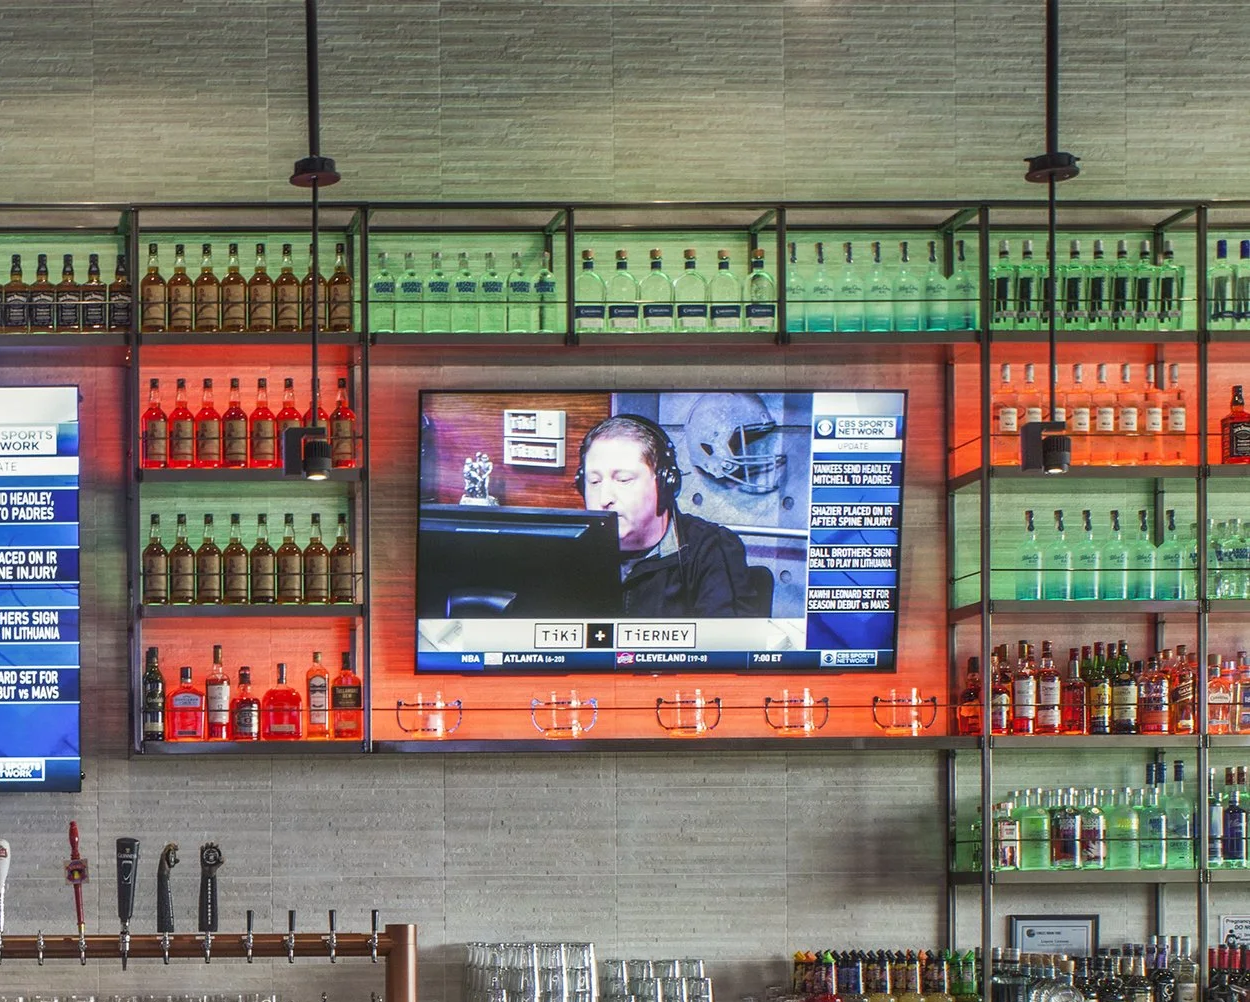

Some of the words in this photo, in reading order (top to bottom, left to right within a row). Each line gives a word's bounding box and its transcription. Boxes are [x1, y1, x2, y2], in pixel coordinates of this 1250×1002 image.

[838, 420, 856, 428] CBS
[859, 420, 894, 428] SPORTS
[2, 430, 53, 441] SPORTS
[838, 442, 868, 450] UPDATE
[813, 464, 842, 474] YANKEES
[844, 464, 861, 474] SEND
[862, 464, 892, 474] HEADLEY,
[813, 475, 850, 484] MITCHELL
[852, 475, 860, 484] TO
[862, 475, 892, 484] PADRES
[10, 492, 54, 507] HEADLEY,
[12, 506, 54, 520] PADRES
[812, 506, 842, 516] SHAZIER
[844, 506, 871, 516] PLACED
[873, 506, 882, 516] ON
[884, 506, 892, 516] IR
[812, 517, 836, 526] AFTER
[838, 517, 862, 526] SPINE
[864, 517, 892, 526] INJURY
[28, 551, 43, 564] ON
[46, 551, 58, 564] IR
[810, 548, 830, 557] BALL
[832, 548, 872, 557] BROTHERS
[873, 548, 892, 557] SIGN
[810, 558, 826, 568] DEAL
[826, 558, 834, 568] TO
[836, 558, 851, 568] PLAY
[852, 558, 859, 568] IN
[860, 558, 892, 568] LITHUANIA
[16, 566, 58, 580] INJURY
[808, 590, 830, 598] KAWHI
[832, 590, 861, 598] LEONARD
[862, 590, 875, 598] SET
[876, 590, 890, 598] FOR
[808, 600, 836, 610] SEASON
[838, 600, 860, 610] DEBUT
[862, 602, 869, 610] vs
[870, 600, 890, 610] MAVS
[32, 612, 58, 624] SIGN
[2, 627, 12, 640] IN
[14, 626, 60, 640] LITHUANIA
[461, 654, 480, 663] NBA
[504, 654, 544, 663] ATLANTA
[545, 654, 565, 664] (6-20)
[635, 654, 686, 662] CLEVELAND
[753, 654, 770, 662] 7:00
[771, 654, 782, 662] ET
[20, 672, 37, 684] SET
[39, 671, 58, 684] FOR
[18, 689, 29, 699] vs
[32, 686, 59, 699] MAVS
